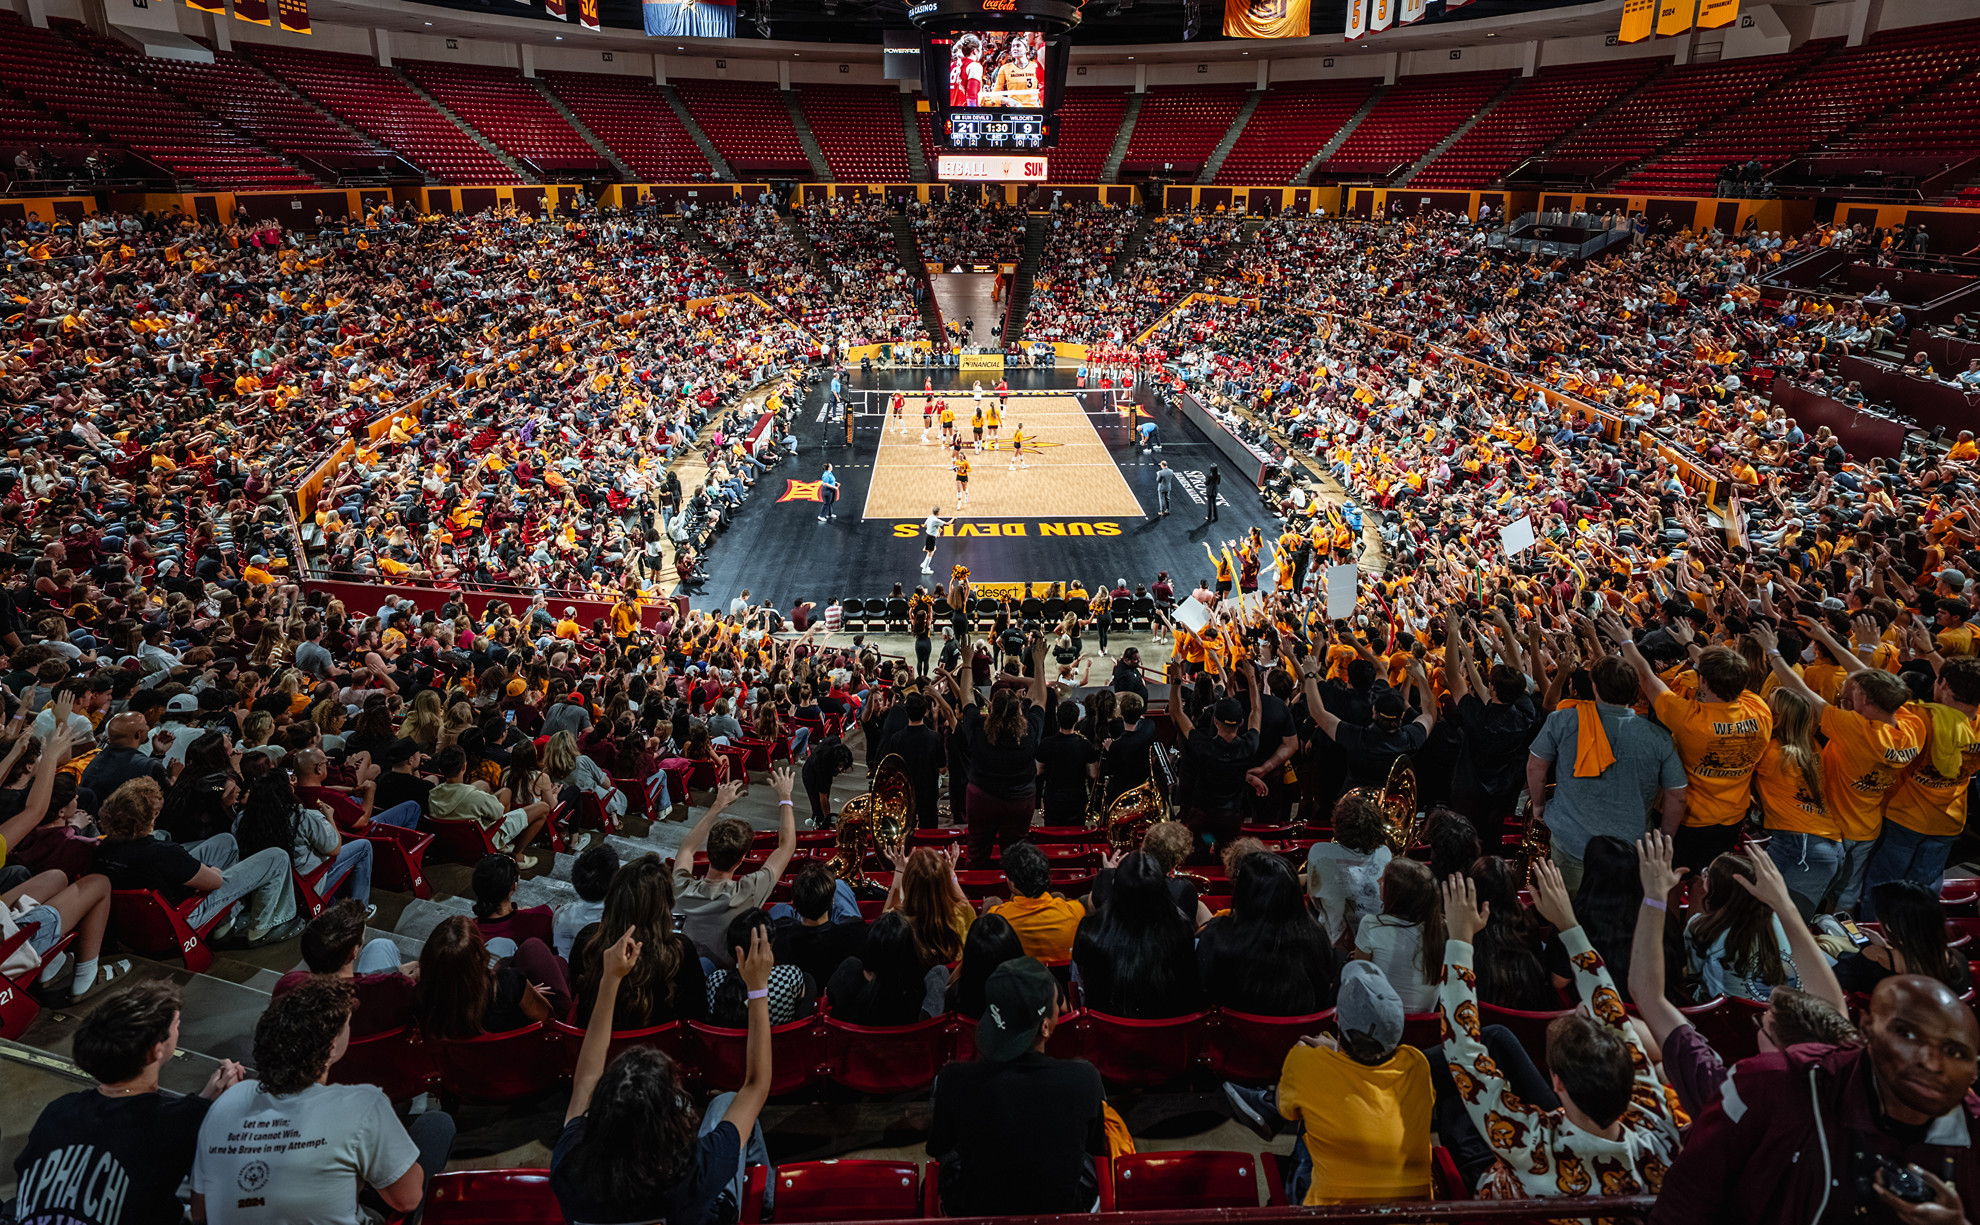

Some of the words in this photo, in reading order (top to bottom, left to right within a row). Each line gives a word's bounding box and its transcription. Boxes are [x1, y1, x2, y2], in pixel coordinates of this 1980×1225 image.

[914, 3, 938, 14] CASINOS
[1707, 0, 1733, 9] TOURNAMENT
[1661, 8, 1676, 17] 2024
[1026, 78, 1033, 88] 3
[958, 123, 974, 133] 21
[986, 123, 1008, 132] 1:30
[1023, 124, 1032, 133] 9
[1024, 162, 1043, 176] SUN
[893, 523, 1027, 538] DEVIS
[1039, 522, 1122, 537] SUN
[1713, 722, 1734, 735] WE
[1735, 718, 1760, 735] RUN
[313, 903, 321, 915] 19
[184, 936, 197, 952] 20
[0, 987, 13, 1005] 21
[243, 1120, 256, 1129] Let
[227, 1133, 240, 1142] But
[241, 1132, 249, 1141] if
[253, 1130, 281, 1141] cannot
[283, 1129, 301, 1139] Win,
[227, 1145, 236, 1154] be
[238, 1145, 262, 1155] Brave
[263, 1145, 272, 1153] in
[274, 1145, 287, 1154] my
[288, 1137, 328, 1150] Attempt.
[15, 1144, 94, 1224] ALPHA
[83, 1151, 130, 1225] CHI
